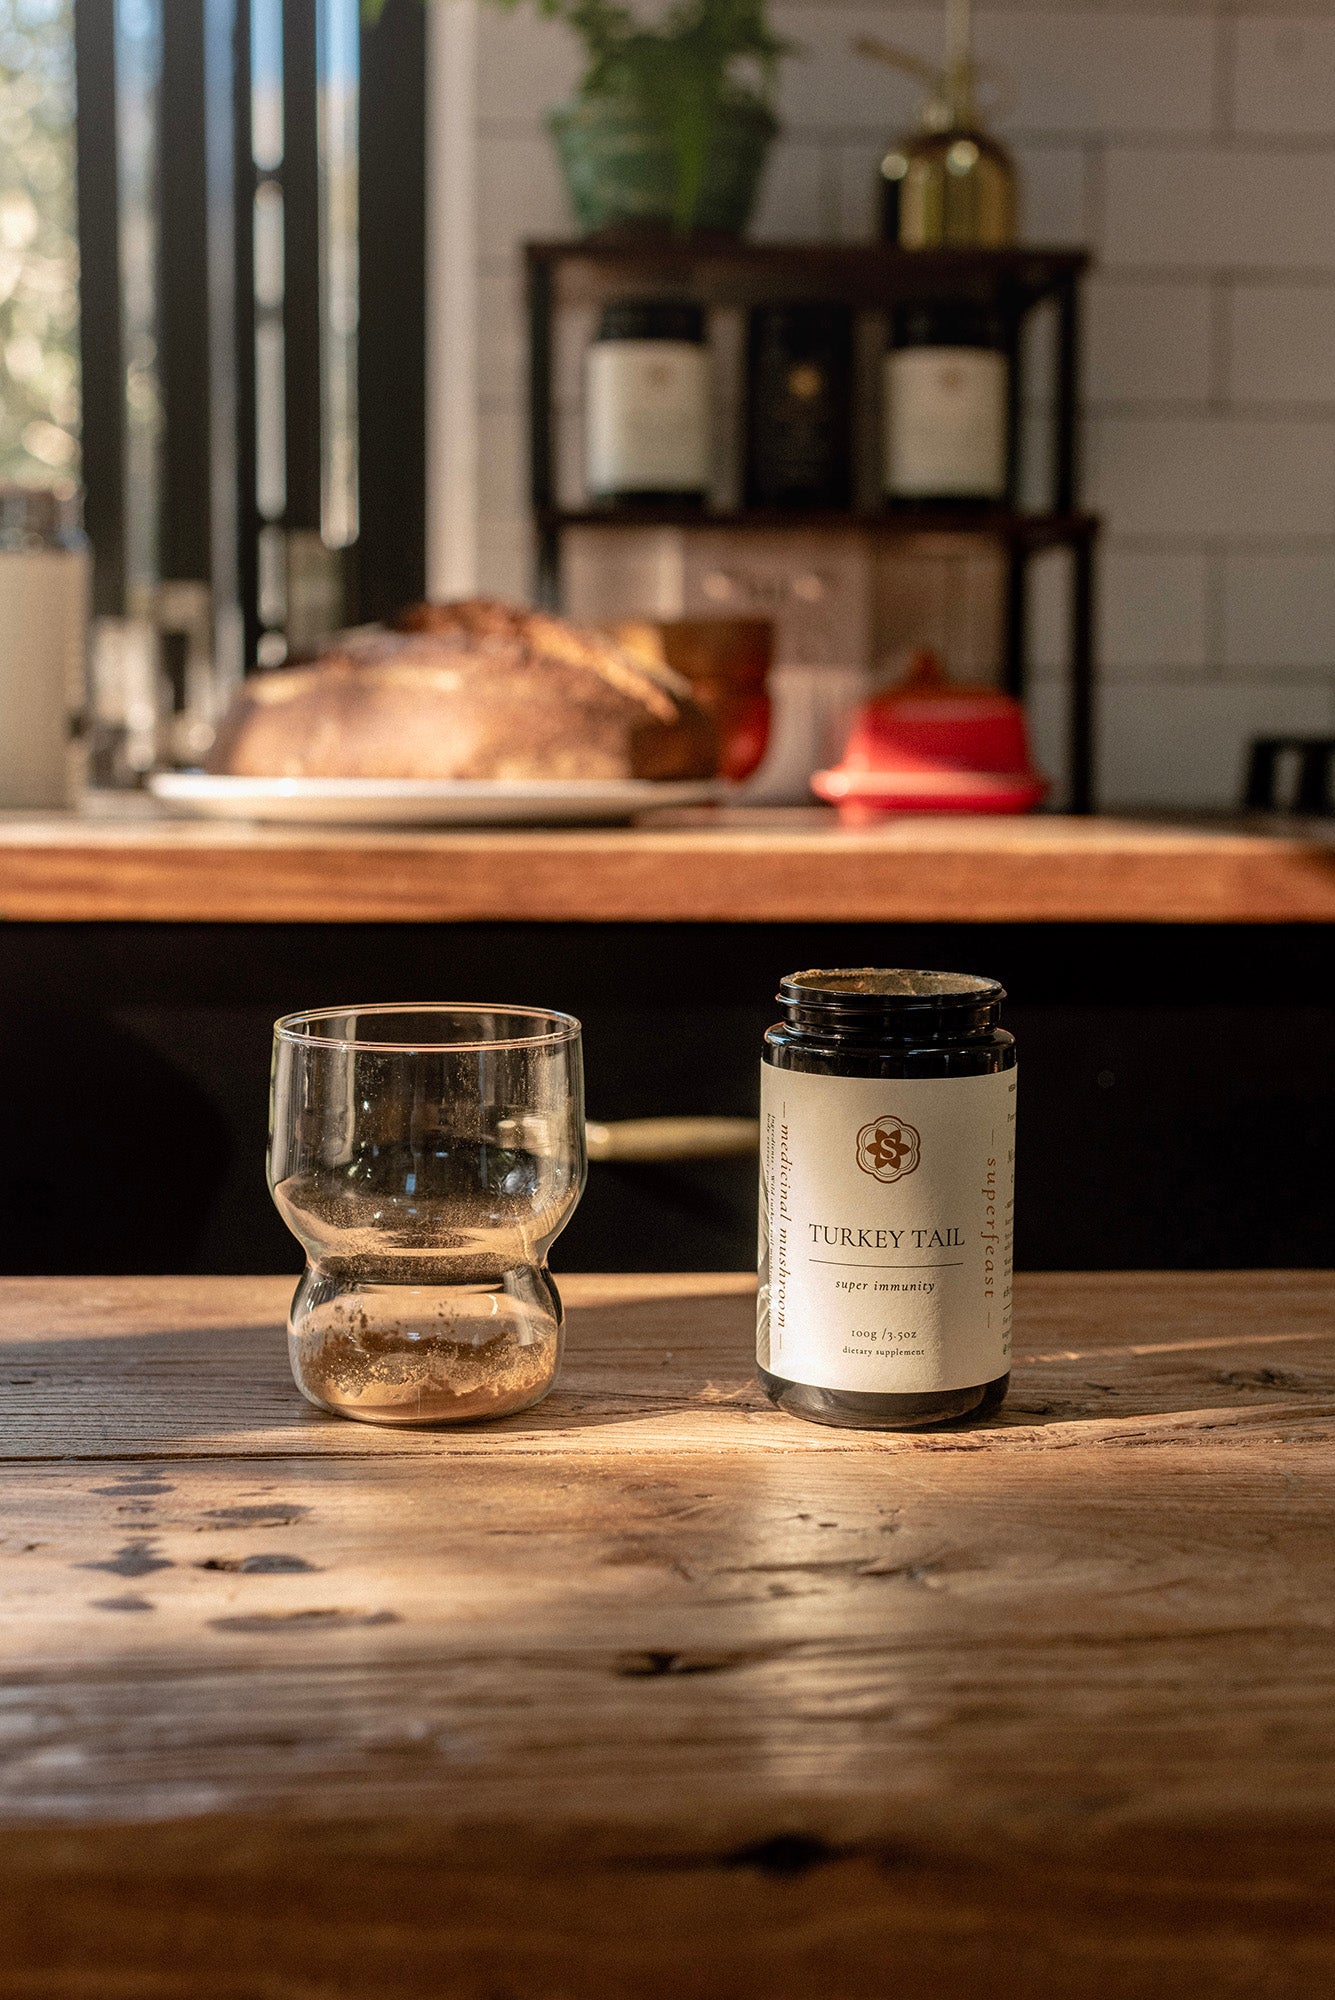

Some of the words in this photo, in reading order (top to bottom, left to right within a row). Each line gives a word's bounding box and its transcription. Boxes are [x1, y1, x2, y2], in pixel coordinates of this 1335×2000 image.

[880, 1138, 897, 1160] S
[780, 1124, 793, 1221] medicinal
[808, 1223, 905, 1249] TURKEY
[911, 1228, 966, 1249] TAIL
[981, 1158, 999, 1298] superfeast
[778, 1228, 791, 1328] mushroom
[835, 1280, 869, 1293] super
[873, 1281, 935, 1295] immunity
[851, 1330, 877, 1341] 100g
[842, 1346, 872, 1357] dietary
[876, 1348, 925, 1358] supplement
